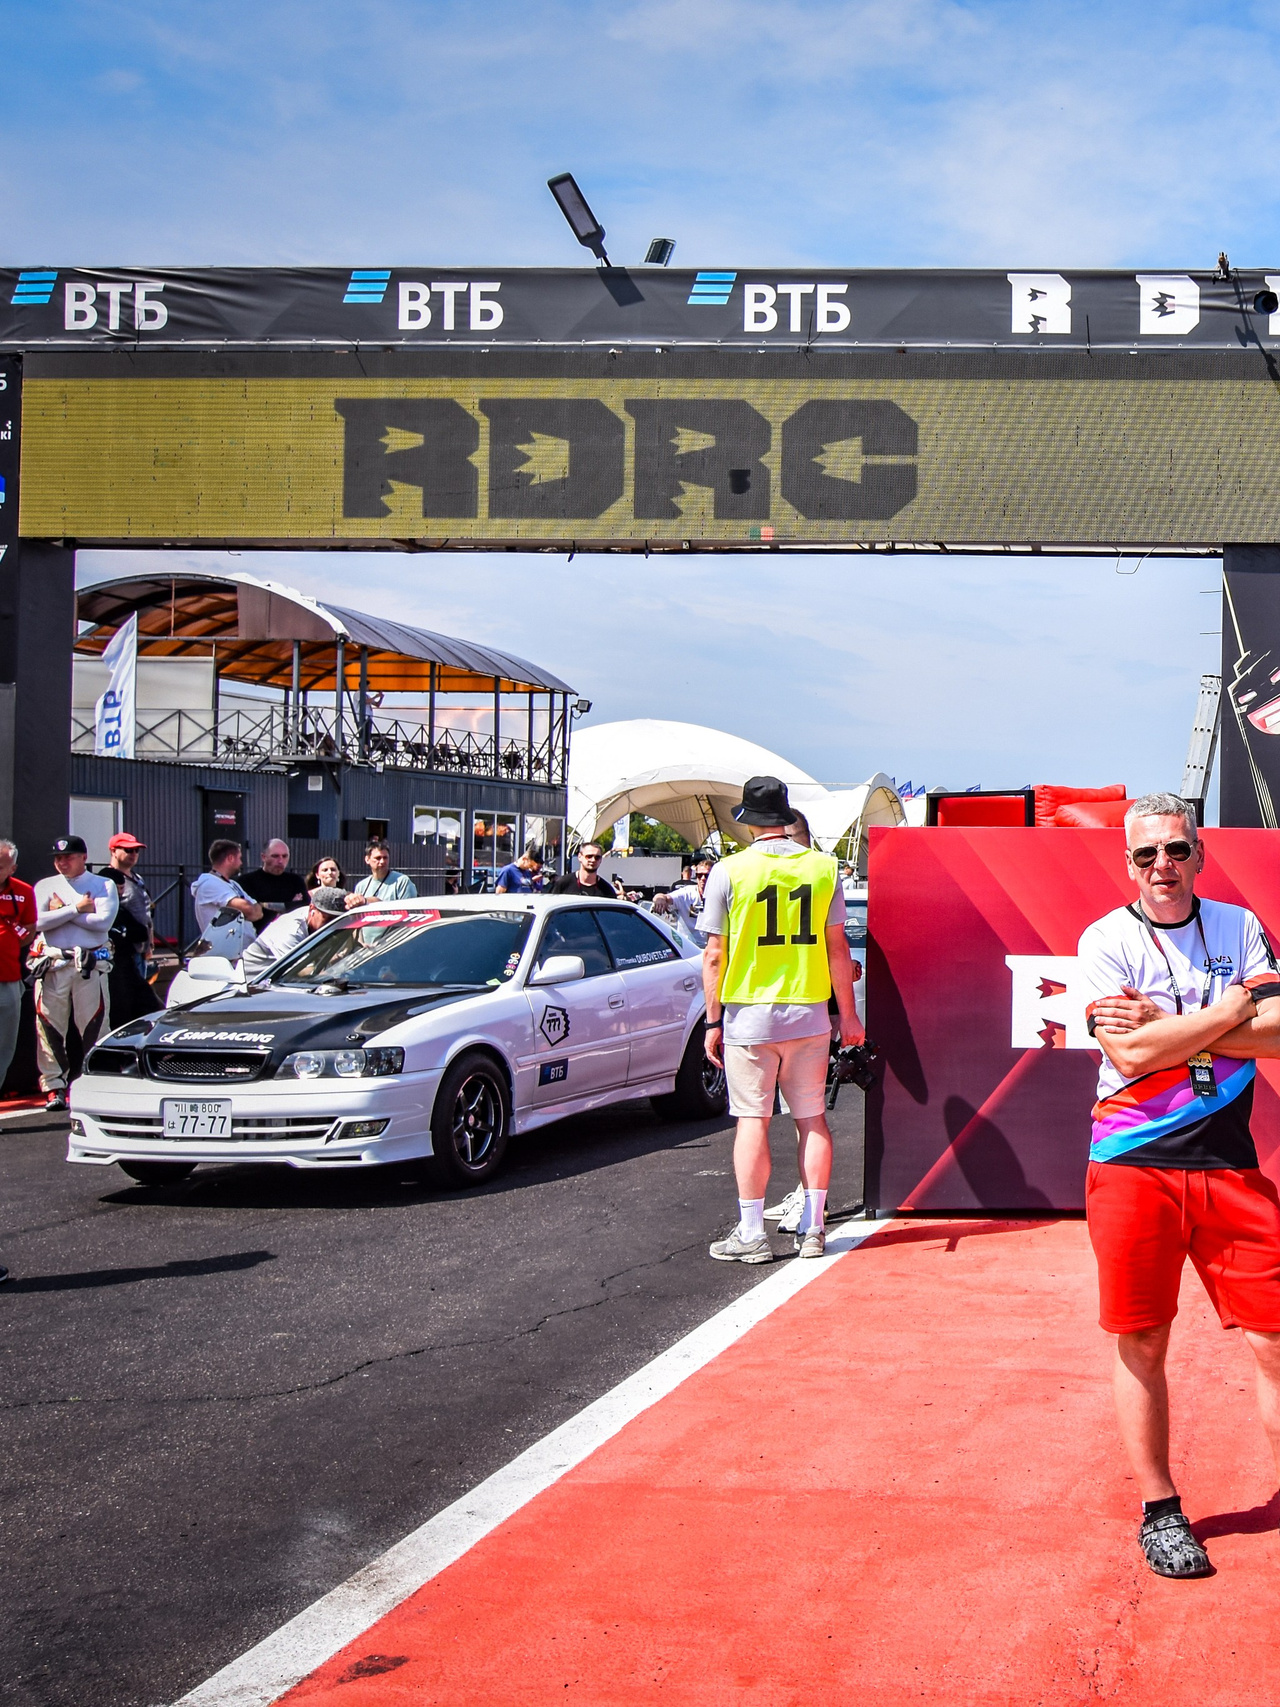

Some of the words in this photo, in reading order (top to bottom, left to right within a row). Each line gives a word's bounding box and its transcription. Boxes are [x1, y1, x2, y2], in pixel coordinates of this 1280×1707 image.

[64, 282, 169, 331] ВТБ
[398, 282, 505, 331] ВТБ
[743, 283, 852, 333] ВТБ
[334, 398, 919, 521] RDRC
[756, 884, 818, 946] 11
[179, 1031, 213, 1041] SMP
[212, 1031, 276, 1044] RACING
[546, 1017, 561, 1033] 777
[550, 1065, 564, 1080] ВТБ
[179, 1115, 227, 1134] 77-77
